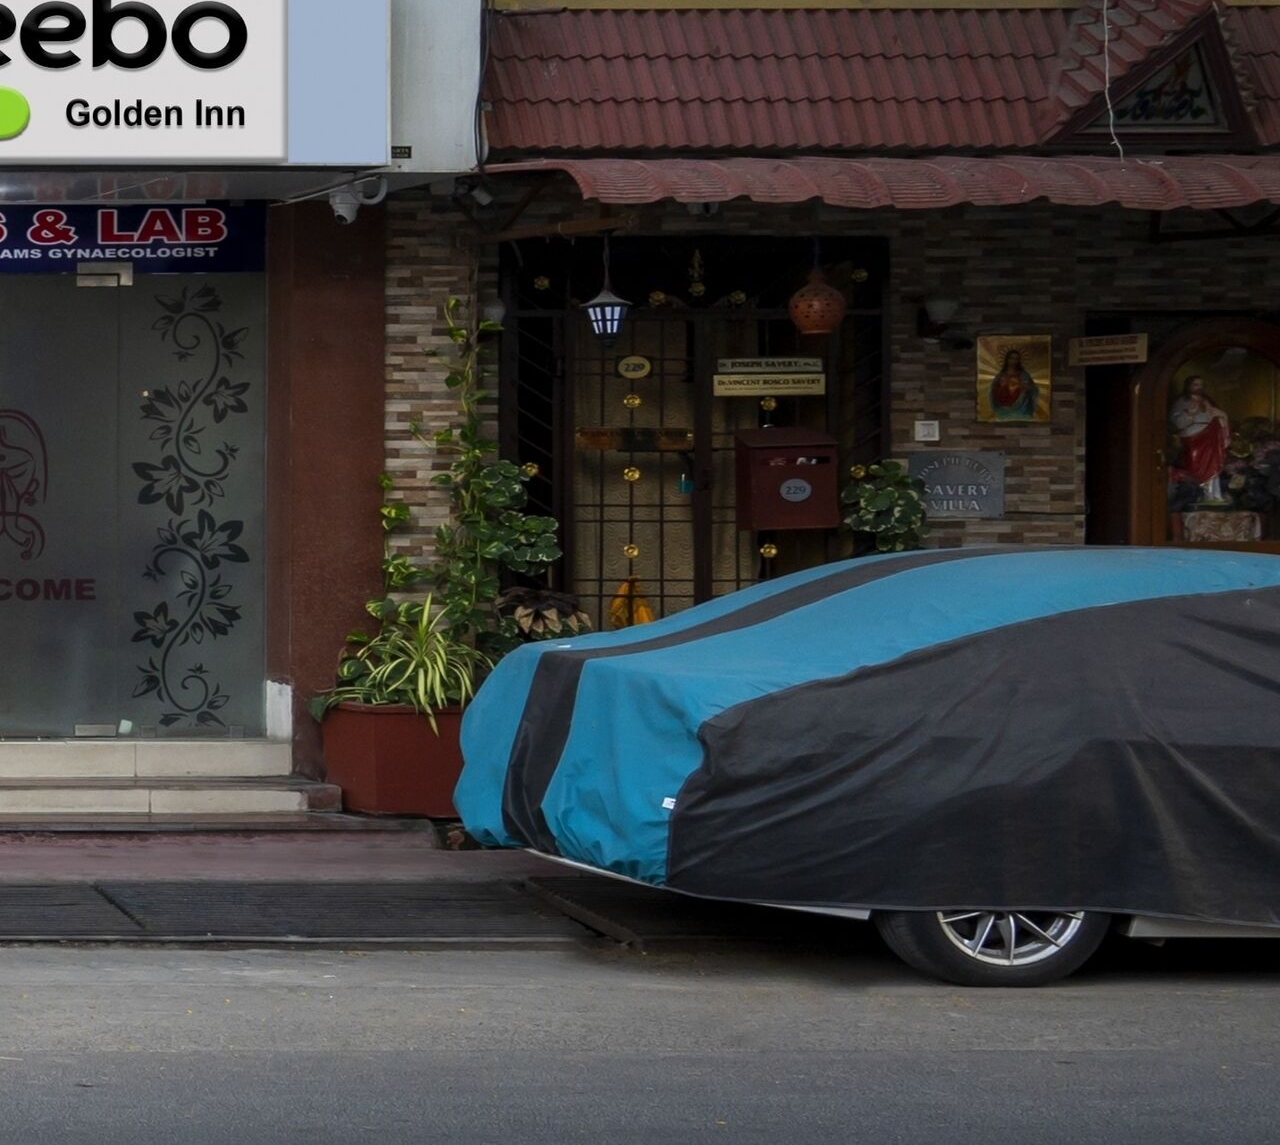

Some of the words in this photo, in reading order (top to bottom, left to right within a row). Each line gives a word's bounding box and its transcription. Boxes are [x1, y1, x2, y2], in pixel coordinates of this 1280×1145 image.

[65, 98, 183, 128] Golden
[194, 99, 245, 127] Inn
[27, 208, 78, 246] &
[97, 207, 228, 245] LAB
[48, 247, 219, 259] GYNAECOLOGIST
[785, 485, 807, 495] 229
[924, 484, 989, 496] SAVERY
[930, 500, 983, 511] VILLA
